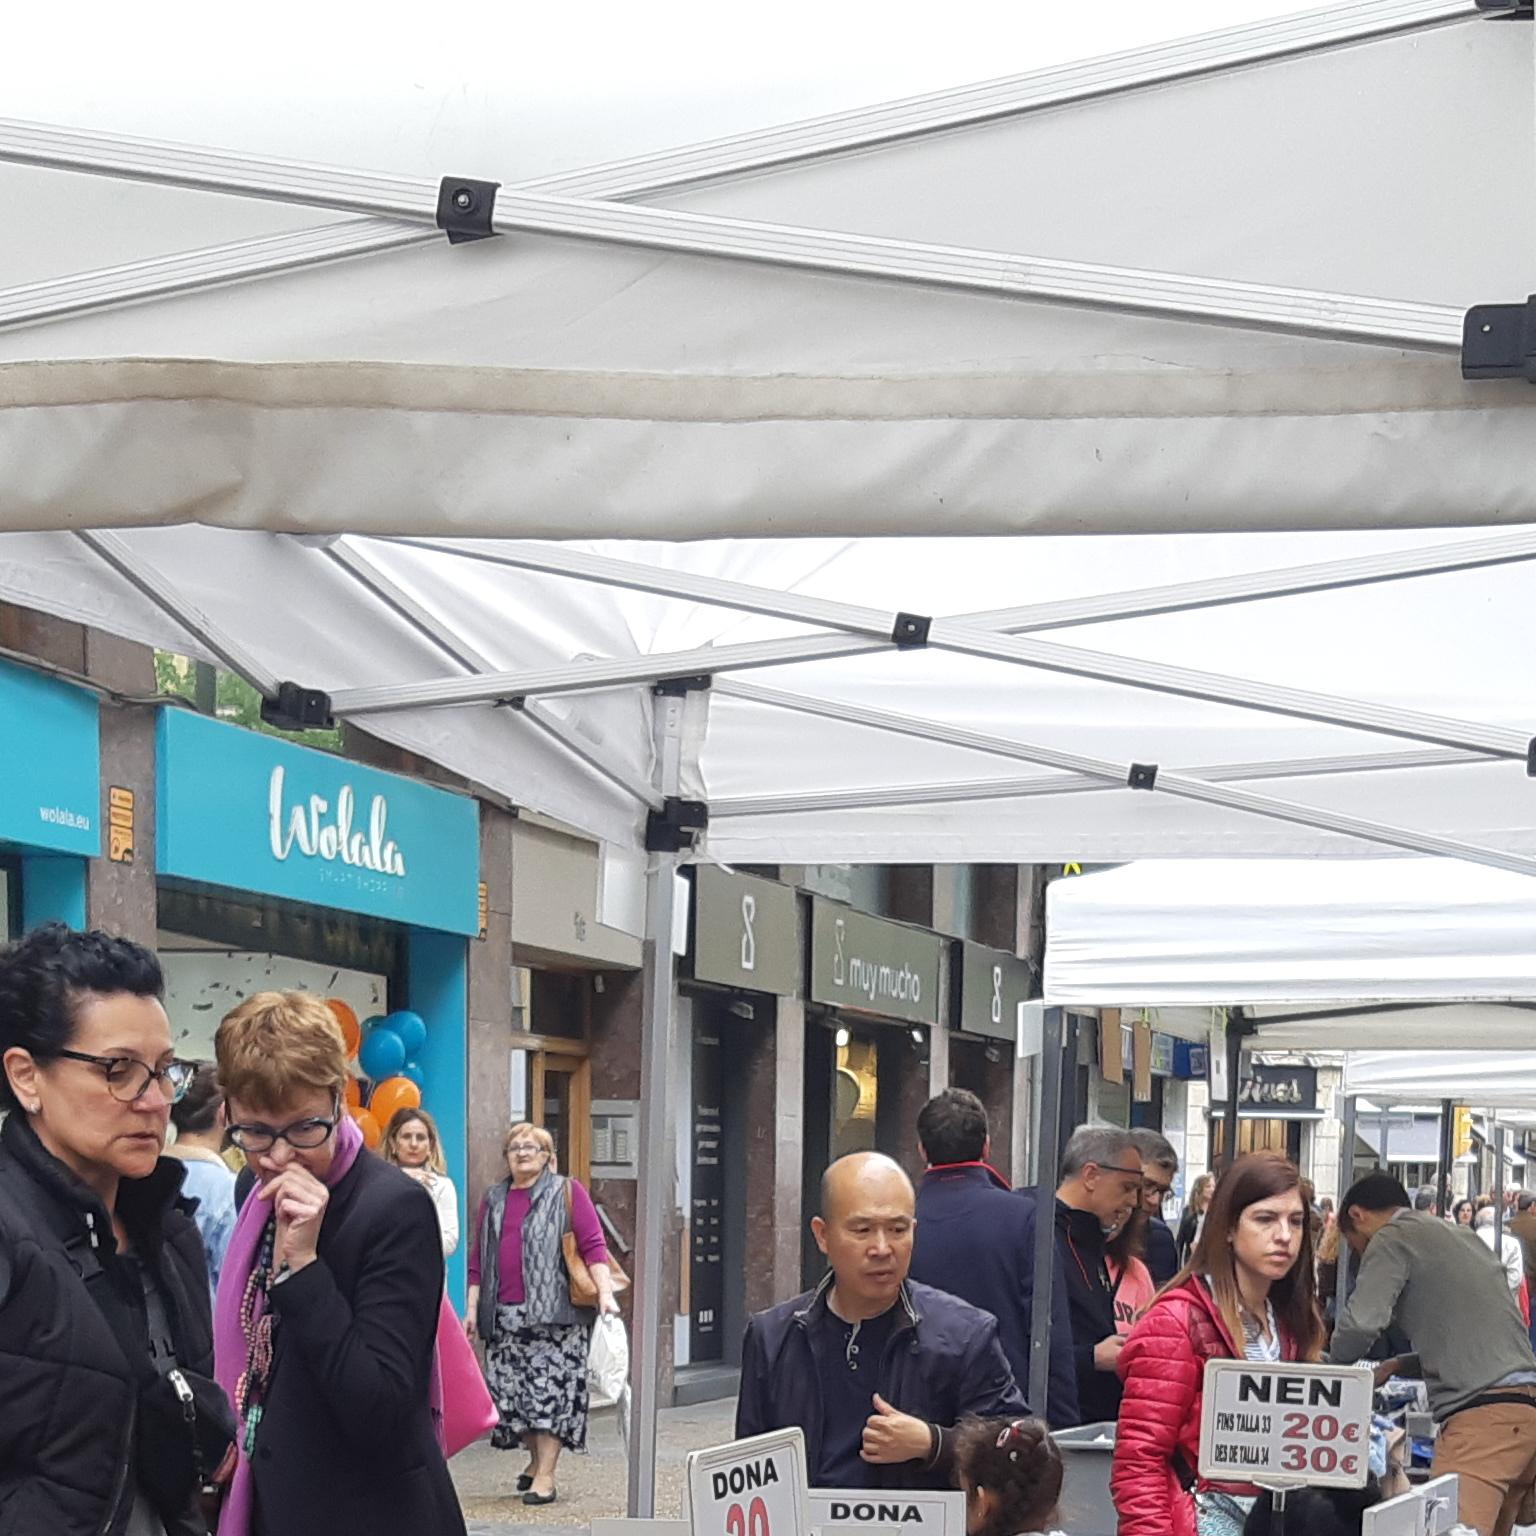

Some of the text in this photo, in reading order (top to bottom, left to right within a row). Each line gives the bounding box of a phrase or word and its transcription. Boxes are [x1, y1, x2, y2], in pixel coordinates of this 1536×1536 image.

[40, 807, 90, 831] wolala.eu
[269, 765, 405, 877] Wolala
[849, 957, 921, 1003] muy mucho
[1238, 1374, 1342, 1408] NEN
[1216, 1412, 1360, 1443] FINS TALLA 33 20€
[1215, 1444, 1228, 1463] DES
[1229, 1445, 1238, 1464] DE
[1239, 1445, 1260, 1466] TALLA
[1280, 1444, 1359, 1475] 30€
[712, 1457, 779, 1501] DONA
[830, 1502, 924, 1523] DONA
